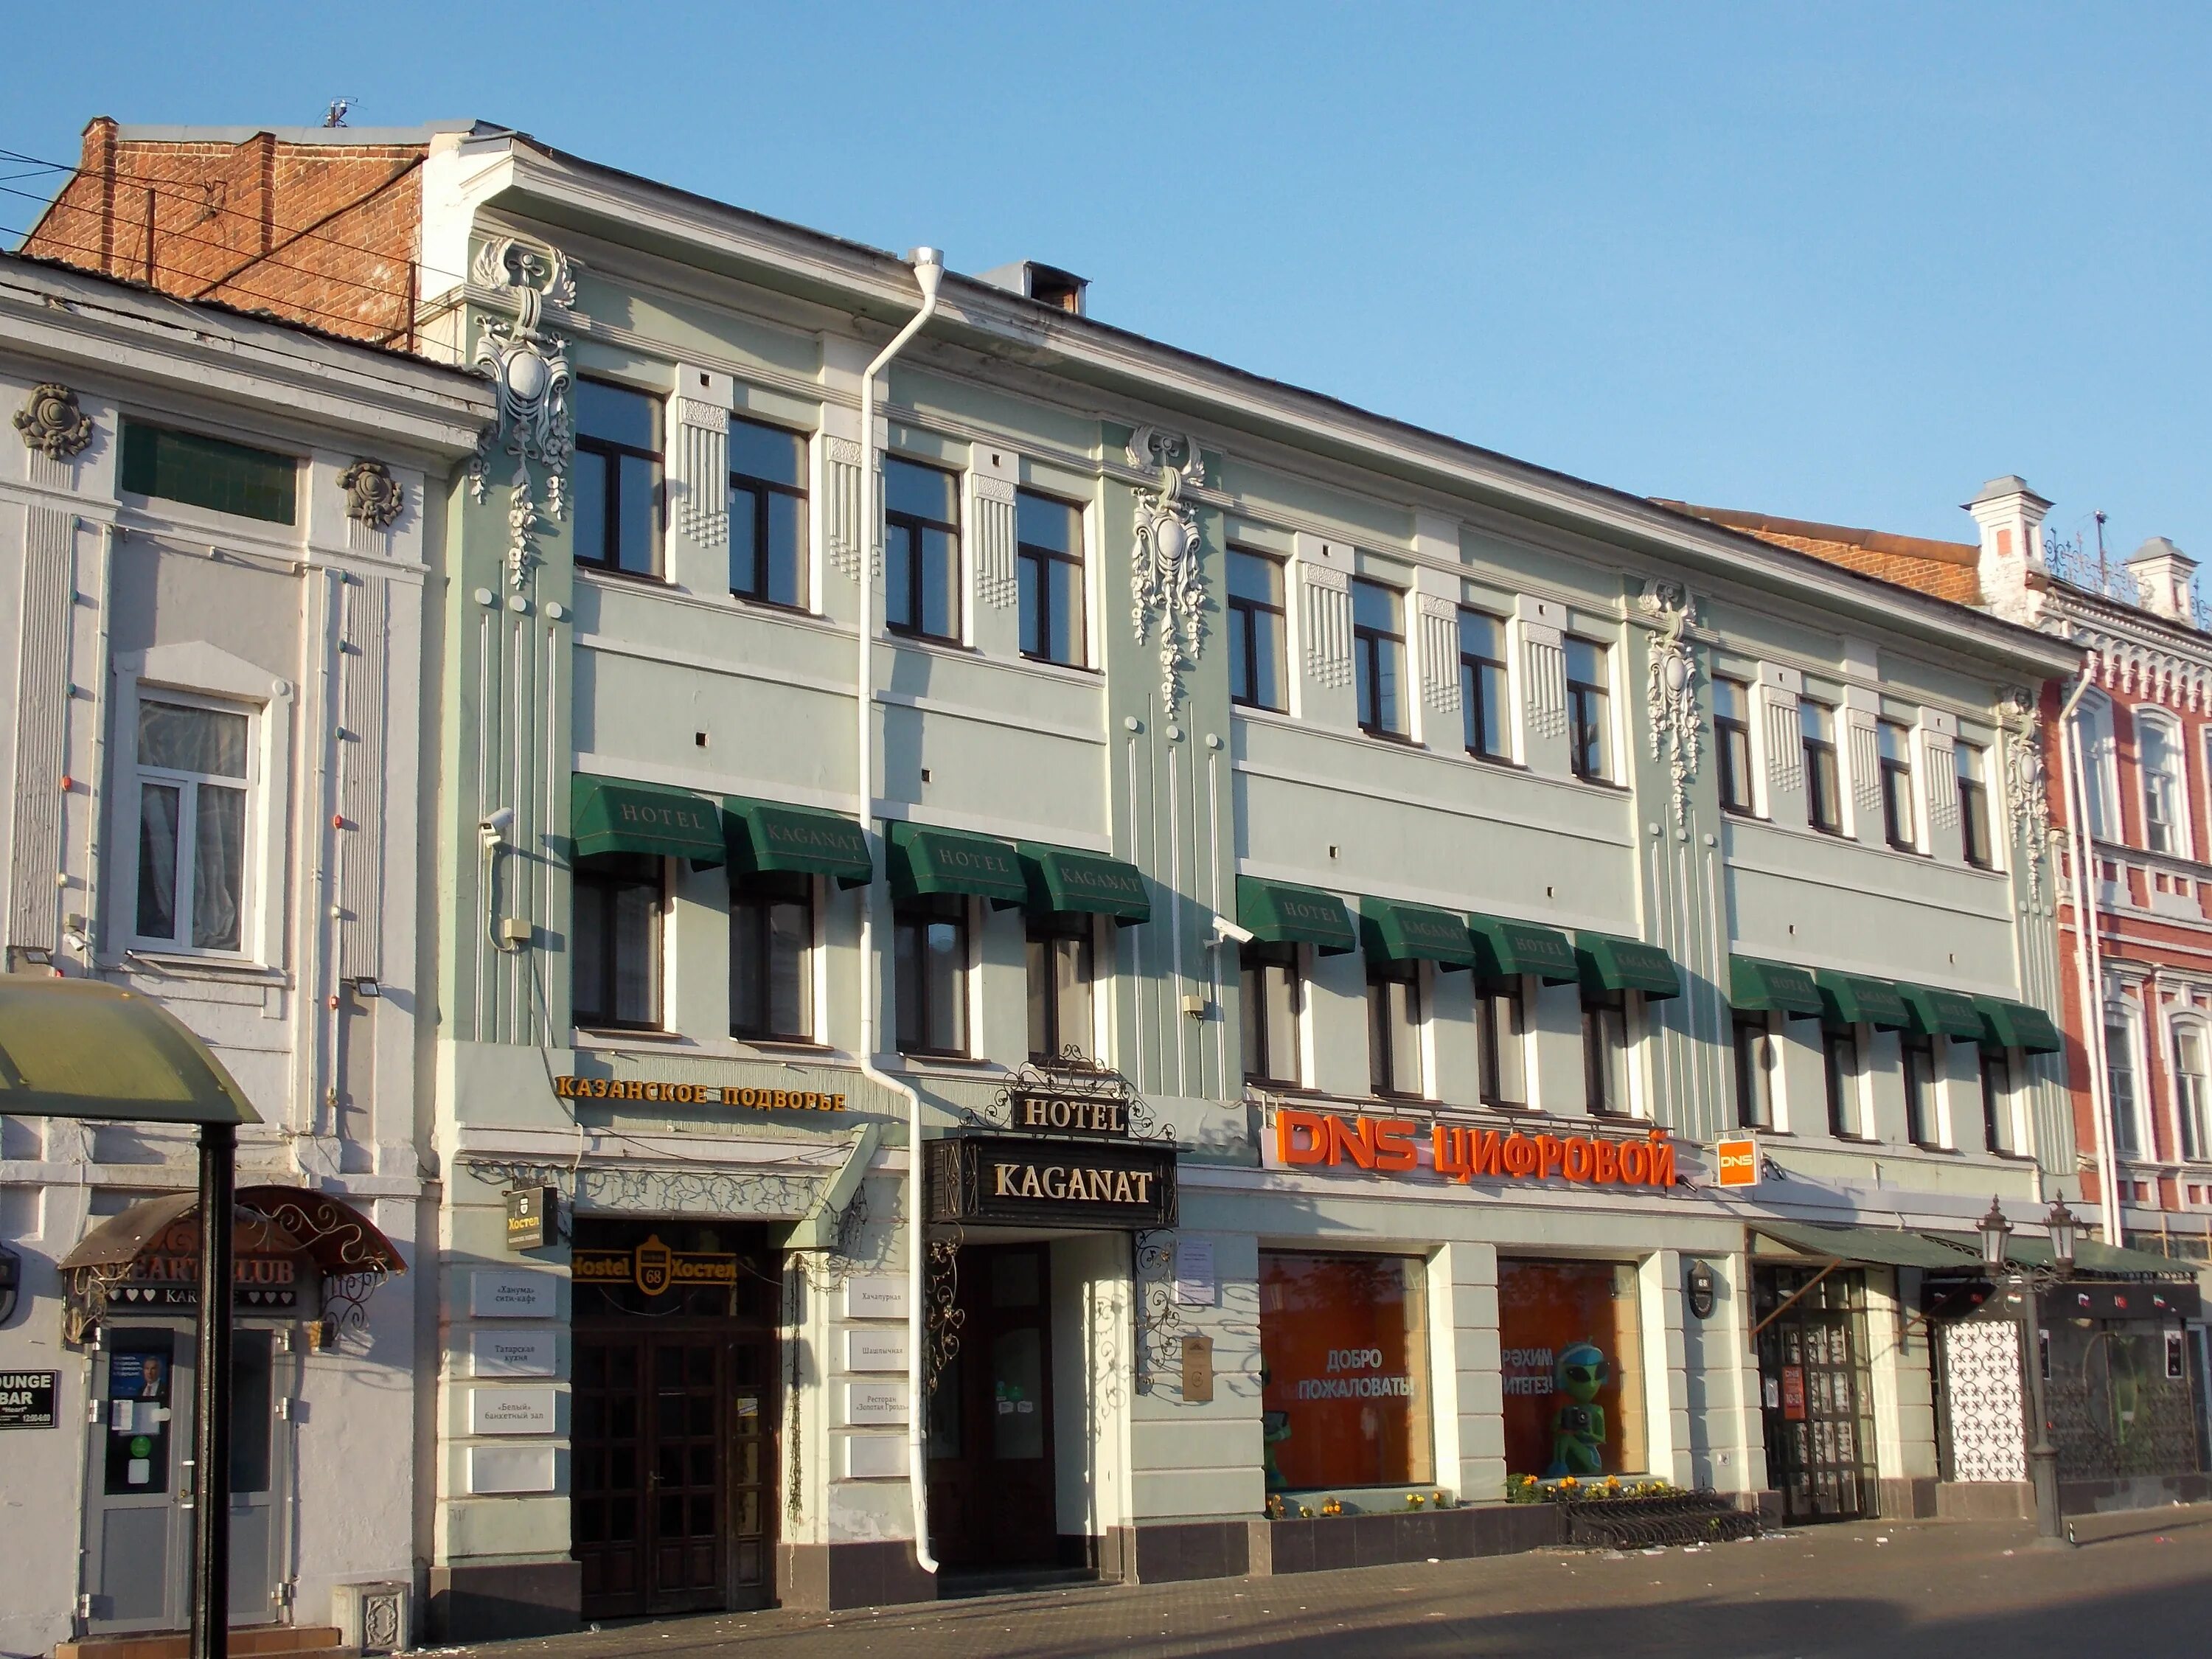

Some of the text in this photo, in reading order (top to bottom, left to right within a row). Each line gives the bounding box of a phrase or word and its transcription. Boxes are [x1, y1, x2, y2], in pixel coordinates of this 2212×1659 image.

[620, 803, 705, 830] HOTEL
[766, 823, 861, 851] KAGANAT
[939, 849, 1009, 873] HOTEL
[1060, 867, 1139, 892] KAGANAT
[1283, 901, 1342, 923] HOTEL
[1402, 919, 1467, 940] KAGANAT
[1515, 936, 1565, 956] HOTEL
[554, 1076, 846, 1112] КАЗАНСКОЕ ПОДВОРЬЕ
[1024, 1099, 1125, 1131] HOTEL
[1276, 1110, 1676, 1186] DNS ЦИФРОВОЙ
[1720, 1154, 1753, 1168] DNS
[994, 1163, 1153, 1203] KAGANAT
[508, 1217, 540, 1231] Хостел
[233, 1259, 294, 1284] LUB
[646, 1270, 661, 1284] 68
[671, 1258, 737, 1278] Хостел
[495, 1294, 536, 1304] сити-кафе
[862, 1293, 901, 1301] Хачапурная
[495, 1345, 535, 1354] Татарская
[1326, 1349, 1382, 1372] ДОБРО
[0, 1374, 51, 1388] UNGE
[1298, 1376, 1414, 1399] ПОЖАЛОВАТЬ!
[0, 1391, 33, 1405] BAR
[867, 1396, 897, 1405] Ресторан
[484, 1411, 528, 1419] банкетный
